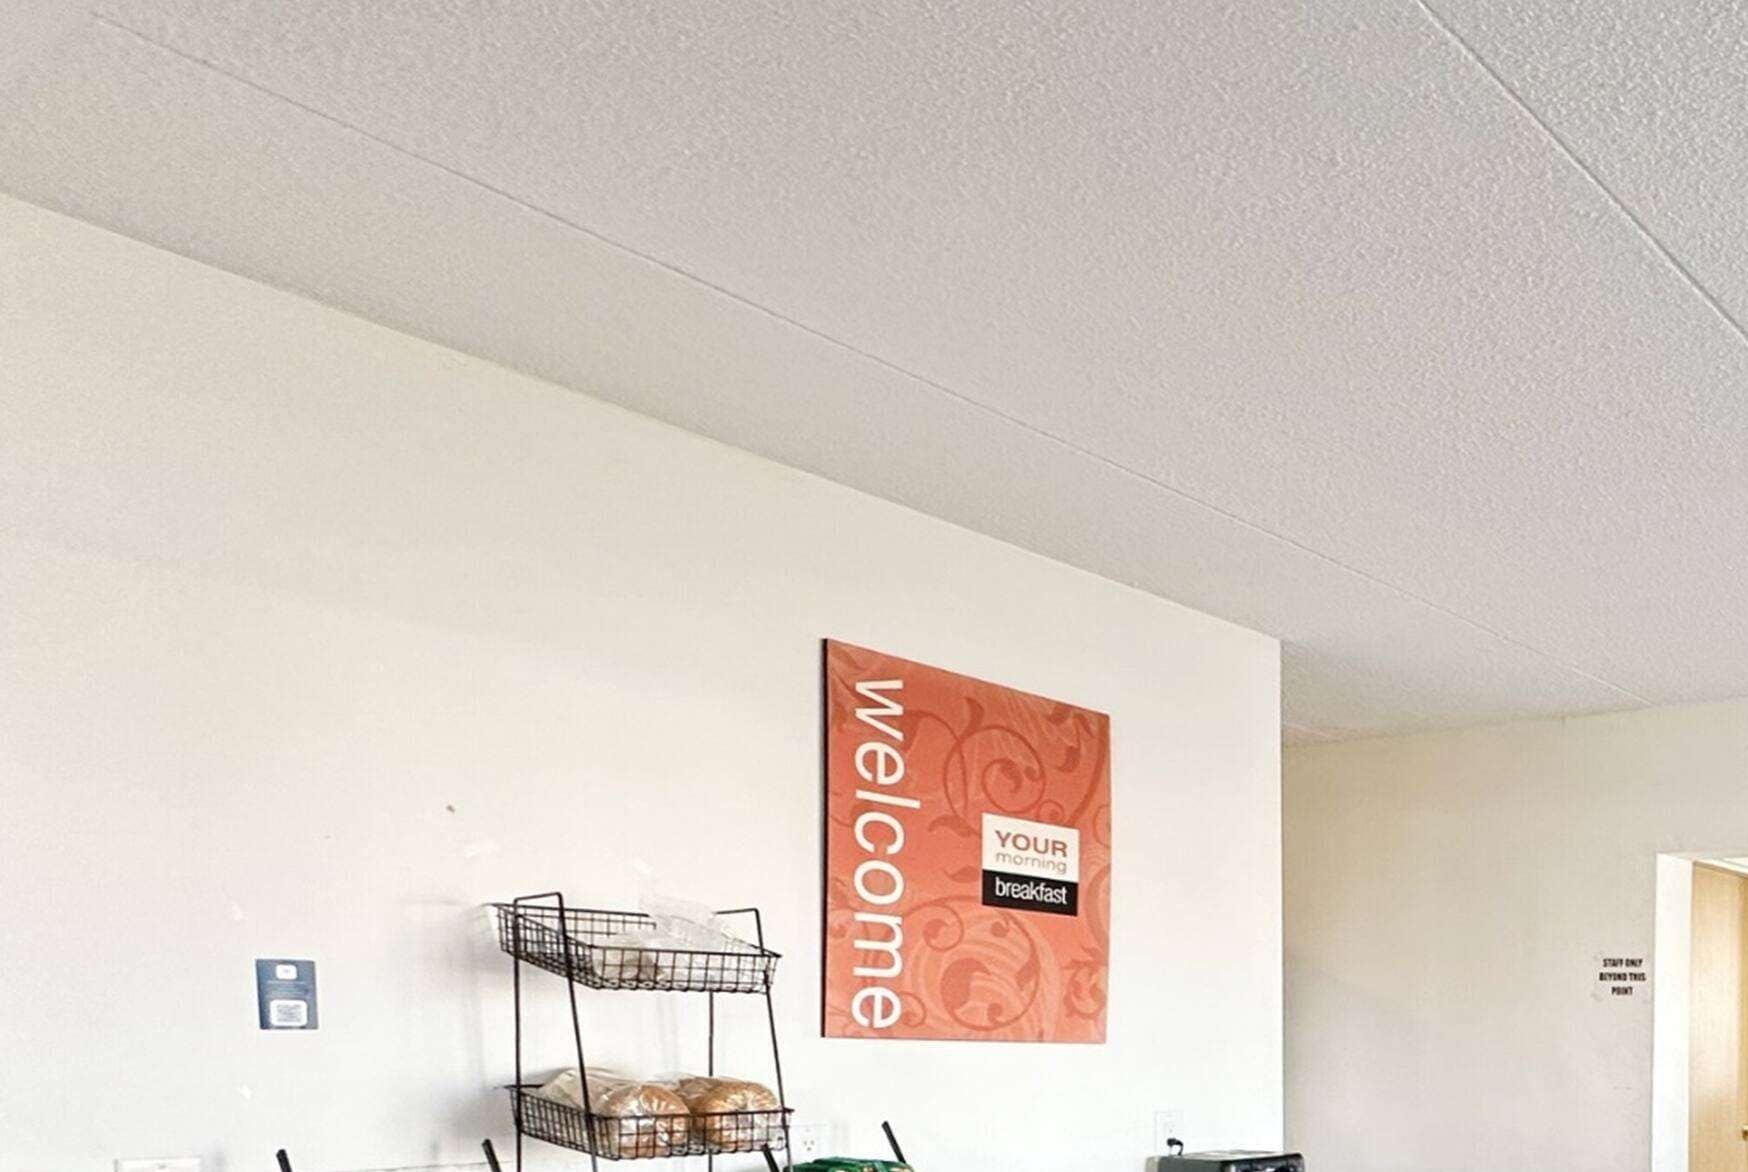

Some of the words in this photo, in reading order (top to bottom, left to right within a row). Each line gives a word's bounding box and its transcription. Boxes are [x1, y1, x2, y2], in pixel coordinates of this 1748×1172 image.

[851, 679, 921, 1028] welcome
[995, 830, 1068, 858] YOUR
[995, 851, 1068, 875] morning
[995, 876, 1068, 904] breakfast
[1625, 958, 1642, 967] ONLY
[1629, 972, 1646, 981] THIS
[1611, 986, 1632, 995] POINT
